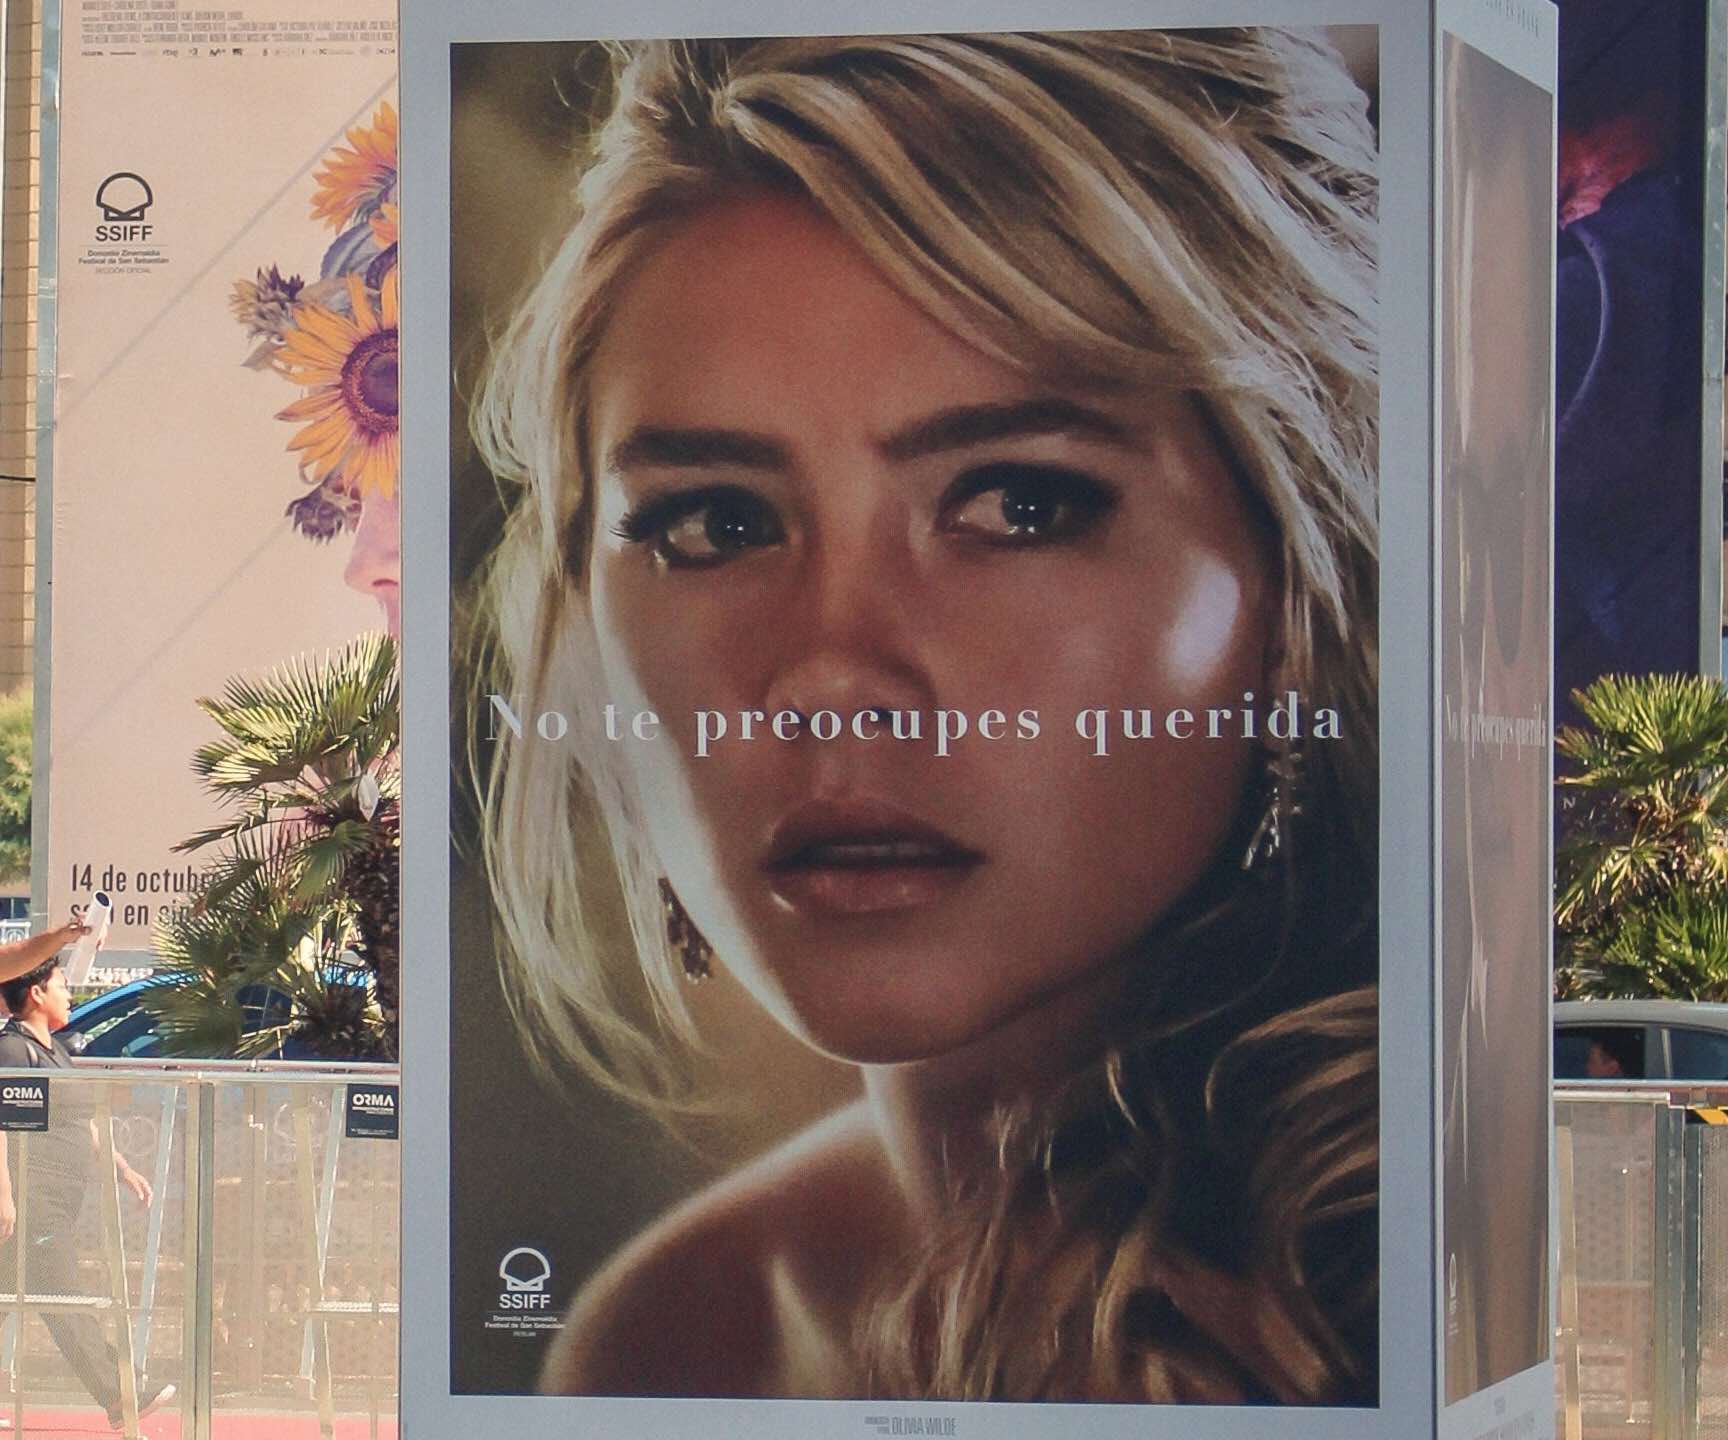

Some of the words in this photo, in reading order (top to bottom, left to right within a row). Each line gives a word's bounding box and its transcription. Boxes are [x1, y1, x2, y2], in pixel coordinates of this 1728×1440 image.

[95, 224, 154, 242] SSIFF
[484, 694, 570, 742] No
[602, 703, 660, 742] te
[693, 708, 1042, 758] preocupes
[1074, 690, 1344, 757] querida
[72, 863, 93, 892] 14
[102, 863, 127, 892] de
[136, 864, 216, 893] octub
[124, 904, 149, 926] en
[498, 1293, 551, 1309] SSIFF
